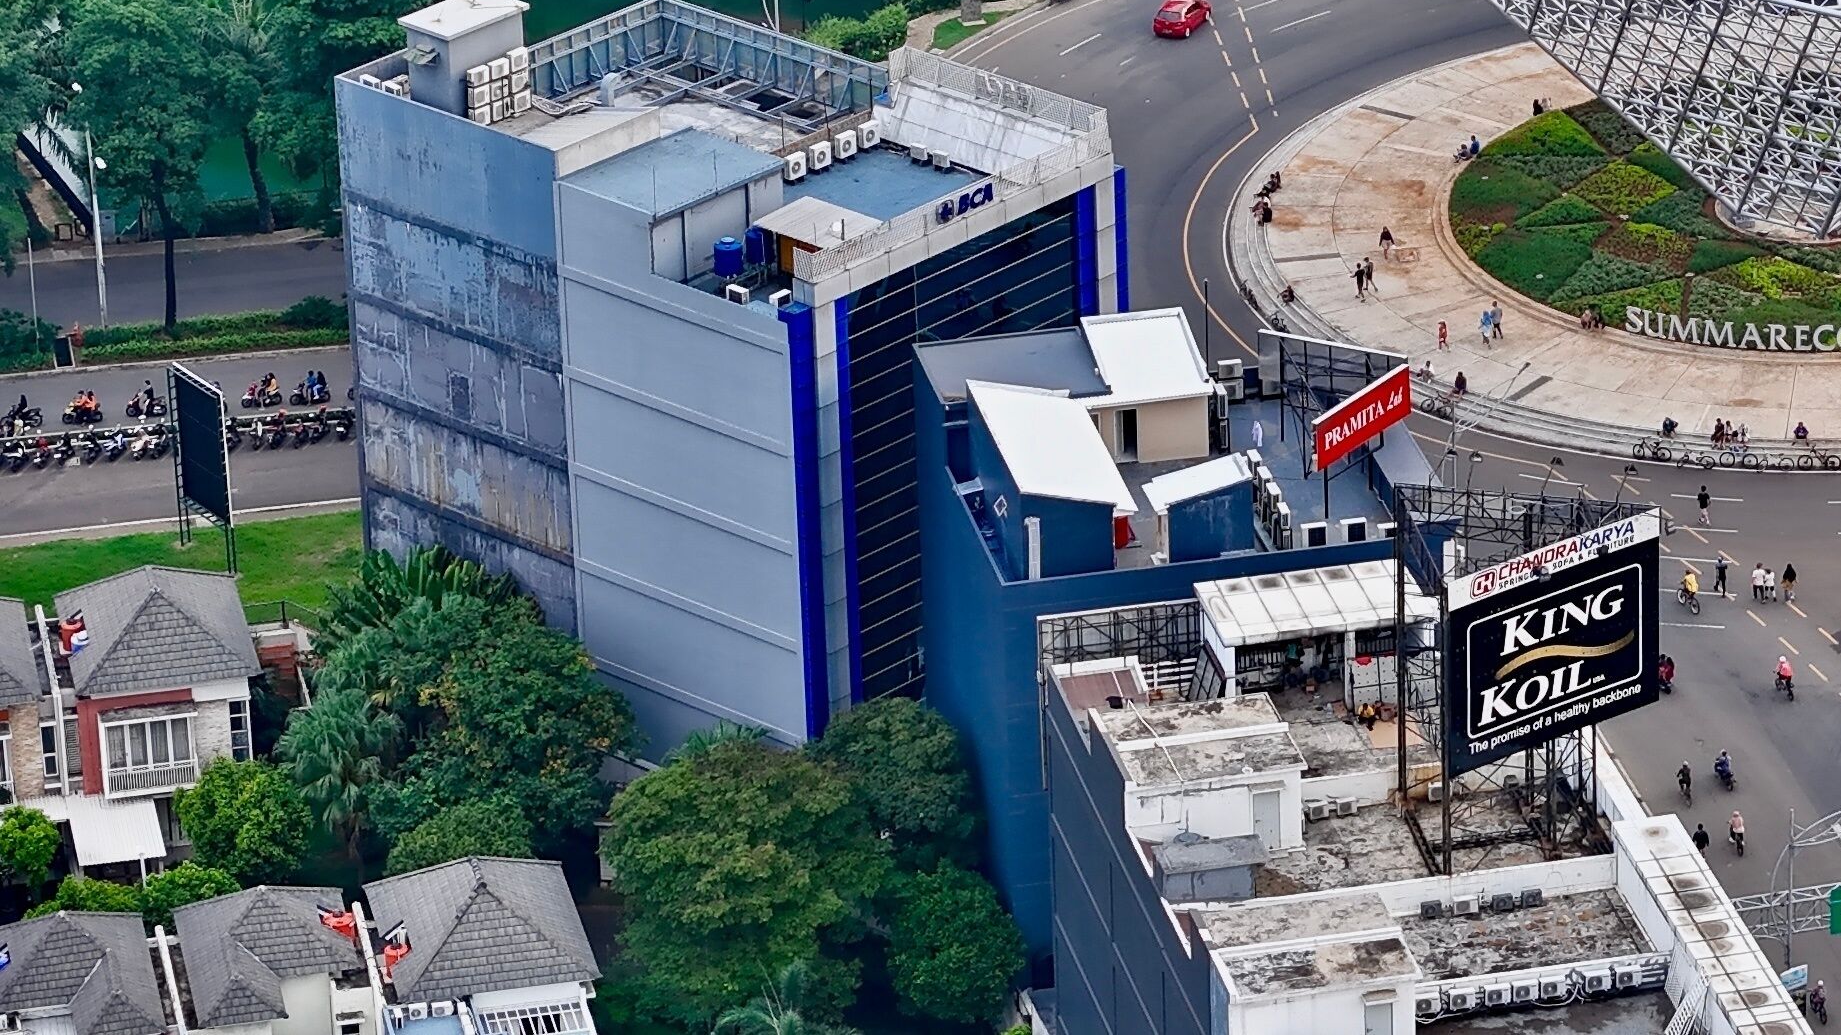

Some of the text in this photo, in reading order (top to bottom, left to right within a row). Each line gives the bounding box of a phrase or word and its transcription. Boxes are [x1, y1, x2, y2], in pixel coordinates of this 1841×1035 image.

[957, 183, 994, 216] BCA
[1324, 400, 1385, 451] PRAMITA
[1499, 520, 1635, 580] CHANDRAKARYA
[1588, 535, 1635, 557] FUITURE
[1500, 584, 1625, 657] KING
[1469, 684, 1642, 755] The promise of a healthy backbone
[1477, 659, 1592, 727] KOIL
